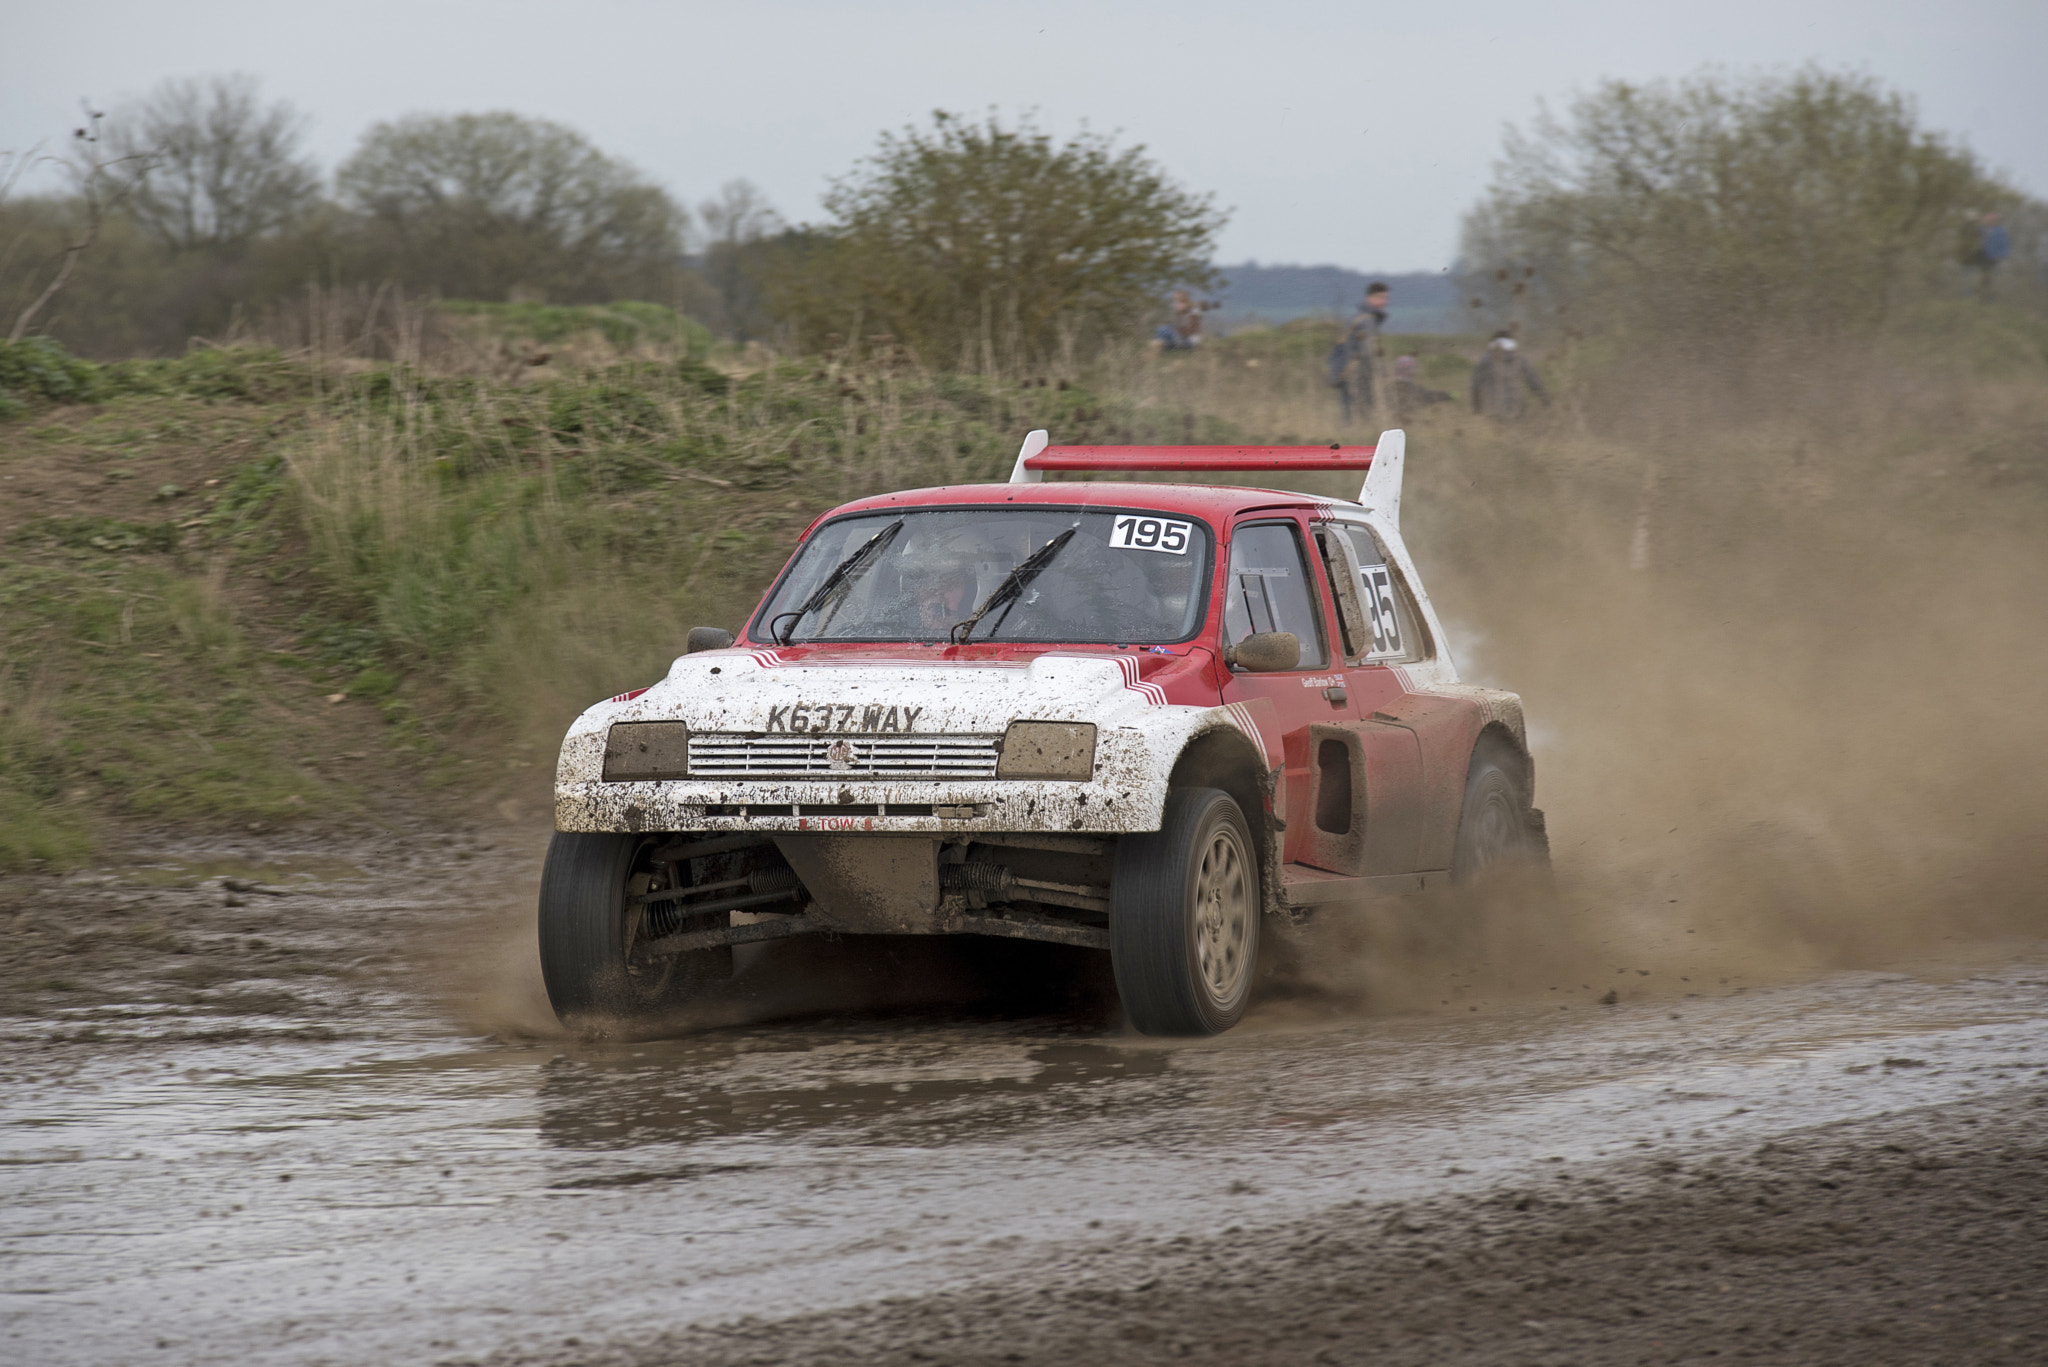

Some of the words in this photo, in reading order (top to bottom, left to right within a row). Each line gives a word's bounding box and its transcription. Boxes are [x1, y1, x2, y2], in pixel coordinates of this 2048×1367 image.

[1117, 518, 1188, 551] 195
[766, 704, 855, 733] K637
[862, 704, 923, 733] WAY
[820, 818, 855, 831] TOW
